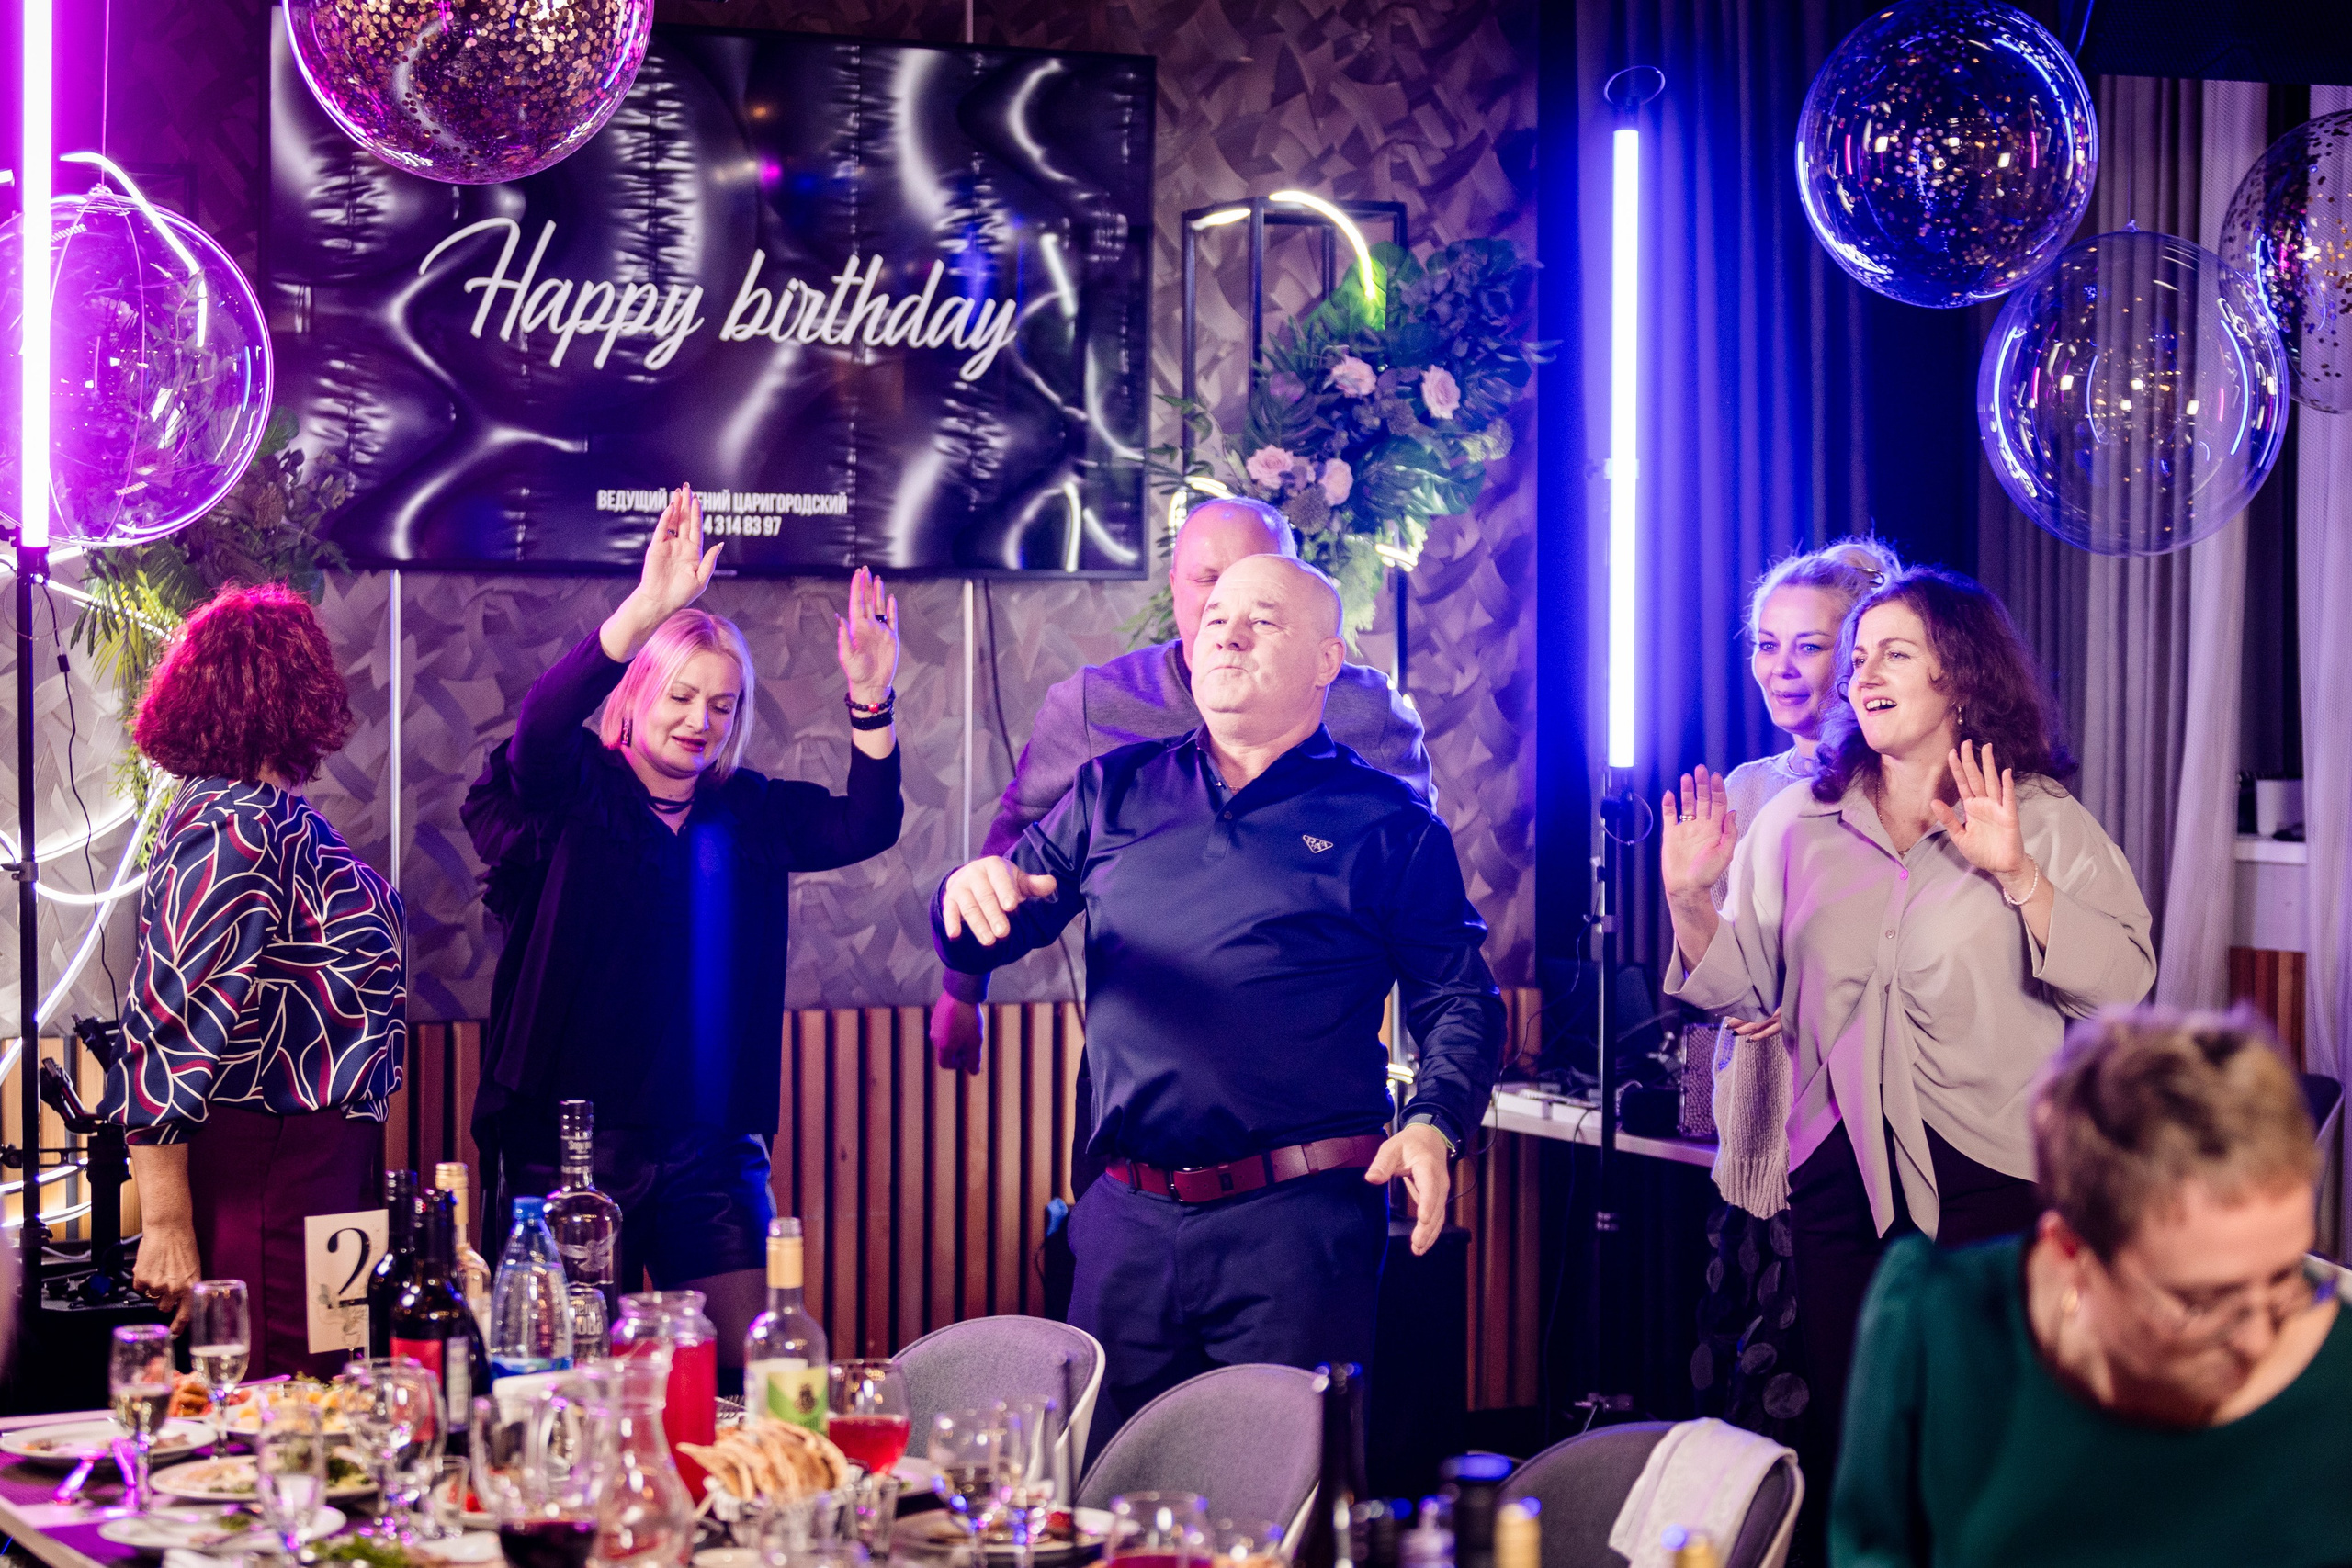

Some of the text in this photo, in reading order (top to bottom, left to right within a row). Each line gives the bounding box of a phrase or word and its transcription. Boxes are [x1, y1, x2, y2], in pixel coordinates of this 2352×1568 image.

[419, 217, 1017, 382] Happy birthday
[596, 487, 668, 513] ВЕДУЩИЙ
[732, 491, 848, 516] ЦАРИГОРОДСКИЙ
[714, 514, 741, 536] 314
[742, 515, 762, 536] 83
[763, 515, 782, 536] 97
[327, 1227, 371, 1310] 2
